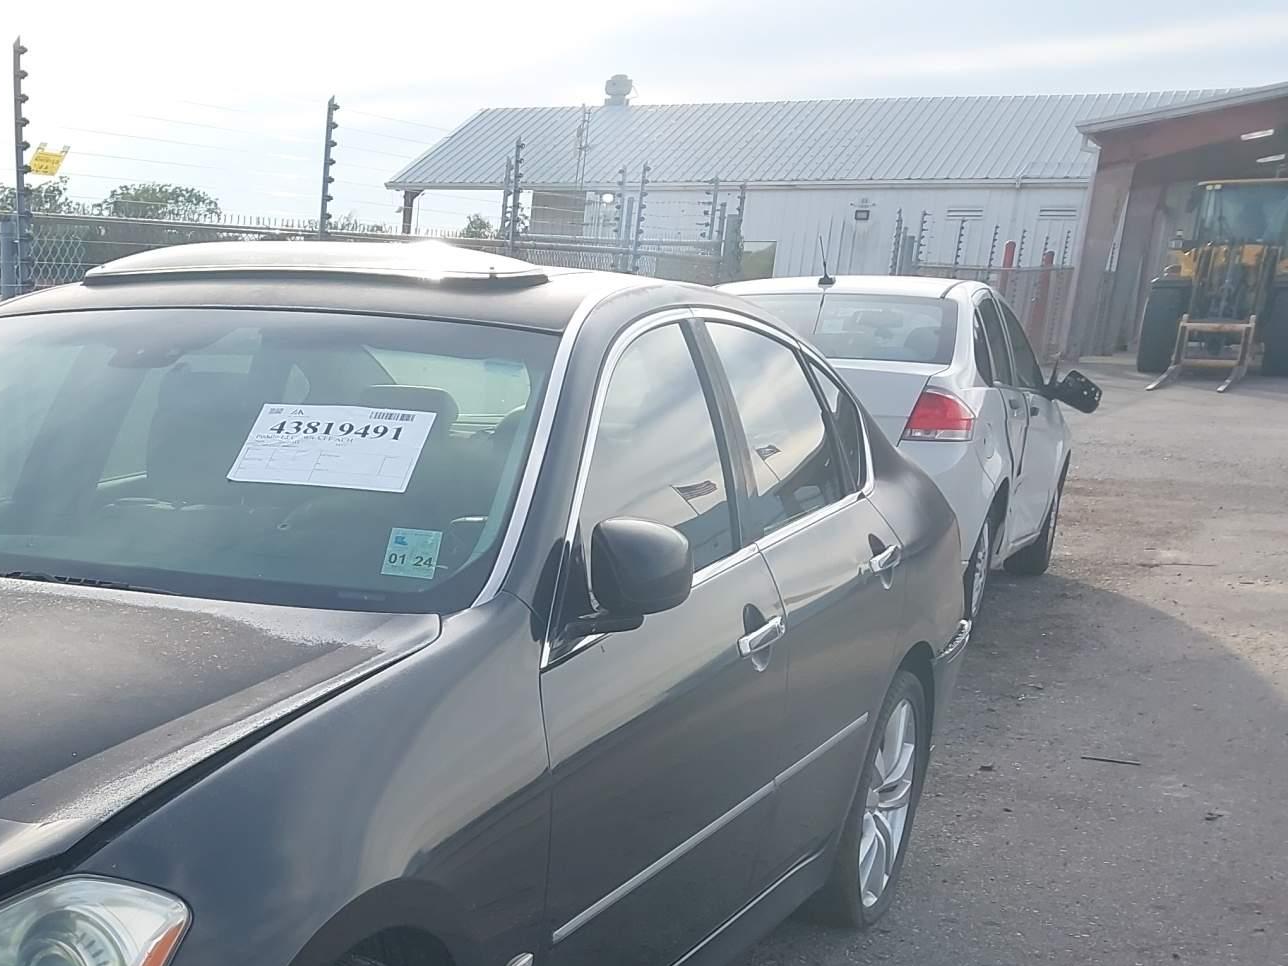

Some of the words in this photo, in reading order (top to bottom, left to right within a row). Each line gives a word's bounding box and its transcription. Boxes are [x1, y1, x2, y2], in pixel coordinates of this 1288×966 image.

[269, 420, 403, 441] 43819491
[388, 552, 407, 565] 01
[413, 555, 433, 568] 24
